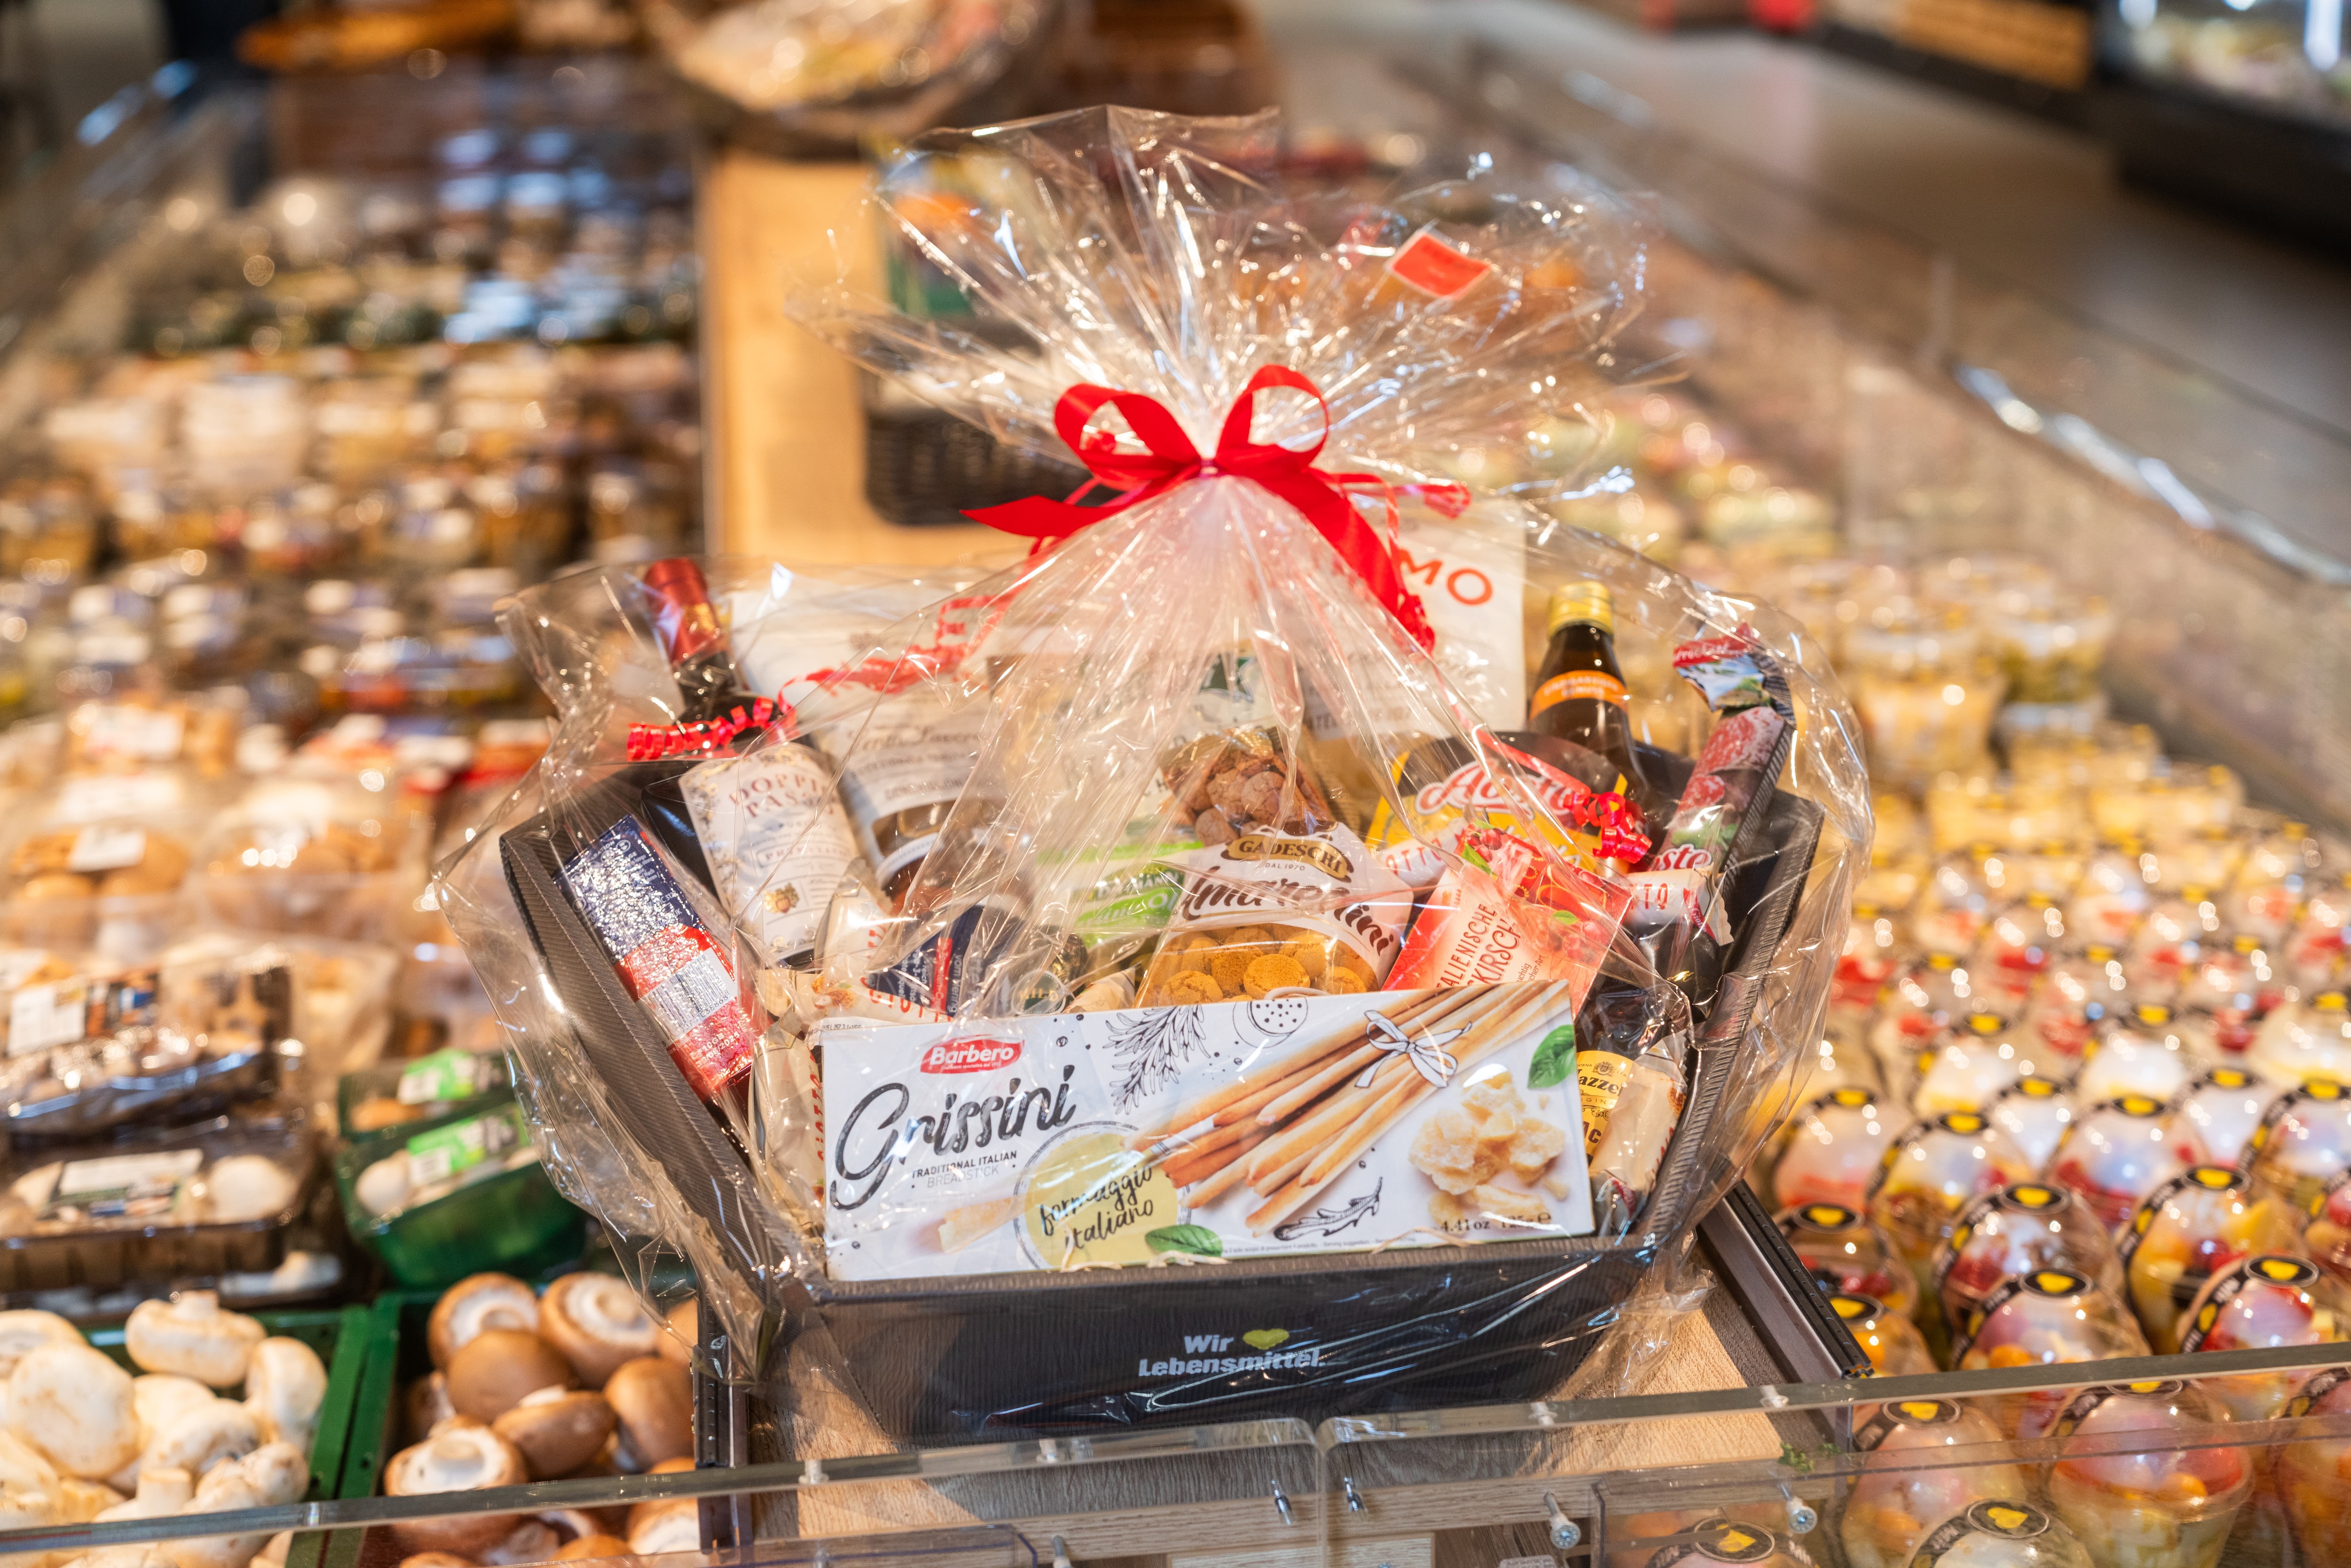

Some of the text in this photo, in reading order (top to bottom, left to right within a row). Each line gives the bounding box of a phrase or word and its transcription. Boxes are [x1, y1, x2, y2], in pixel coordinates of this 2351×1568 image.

[1239, 839, 1342, 874] GADESCHI
[1534, 953, 1546, 966] Art
[930, 1045, 1014, 1065] Barbero
[829, 1064, 1077, 1211] Grissini
[912, 1150, 1017, 1179] TRADITIONAL ITALIAN
[927, 1164, 999, 1188] BREADSTICK
[1040, 1165, 1153, 1236] formaggio
[1065, 1199, 1154, 1249] italiano
[1184, 1334, 1234, 1354] Wir
